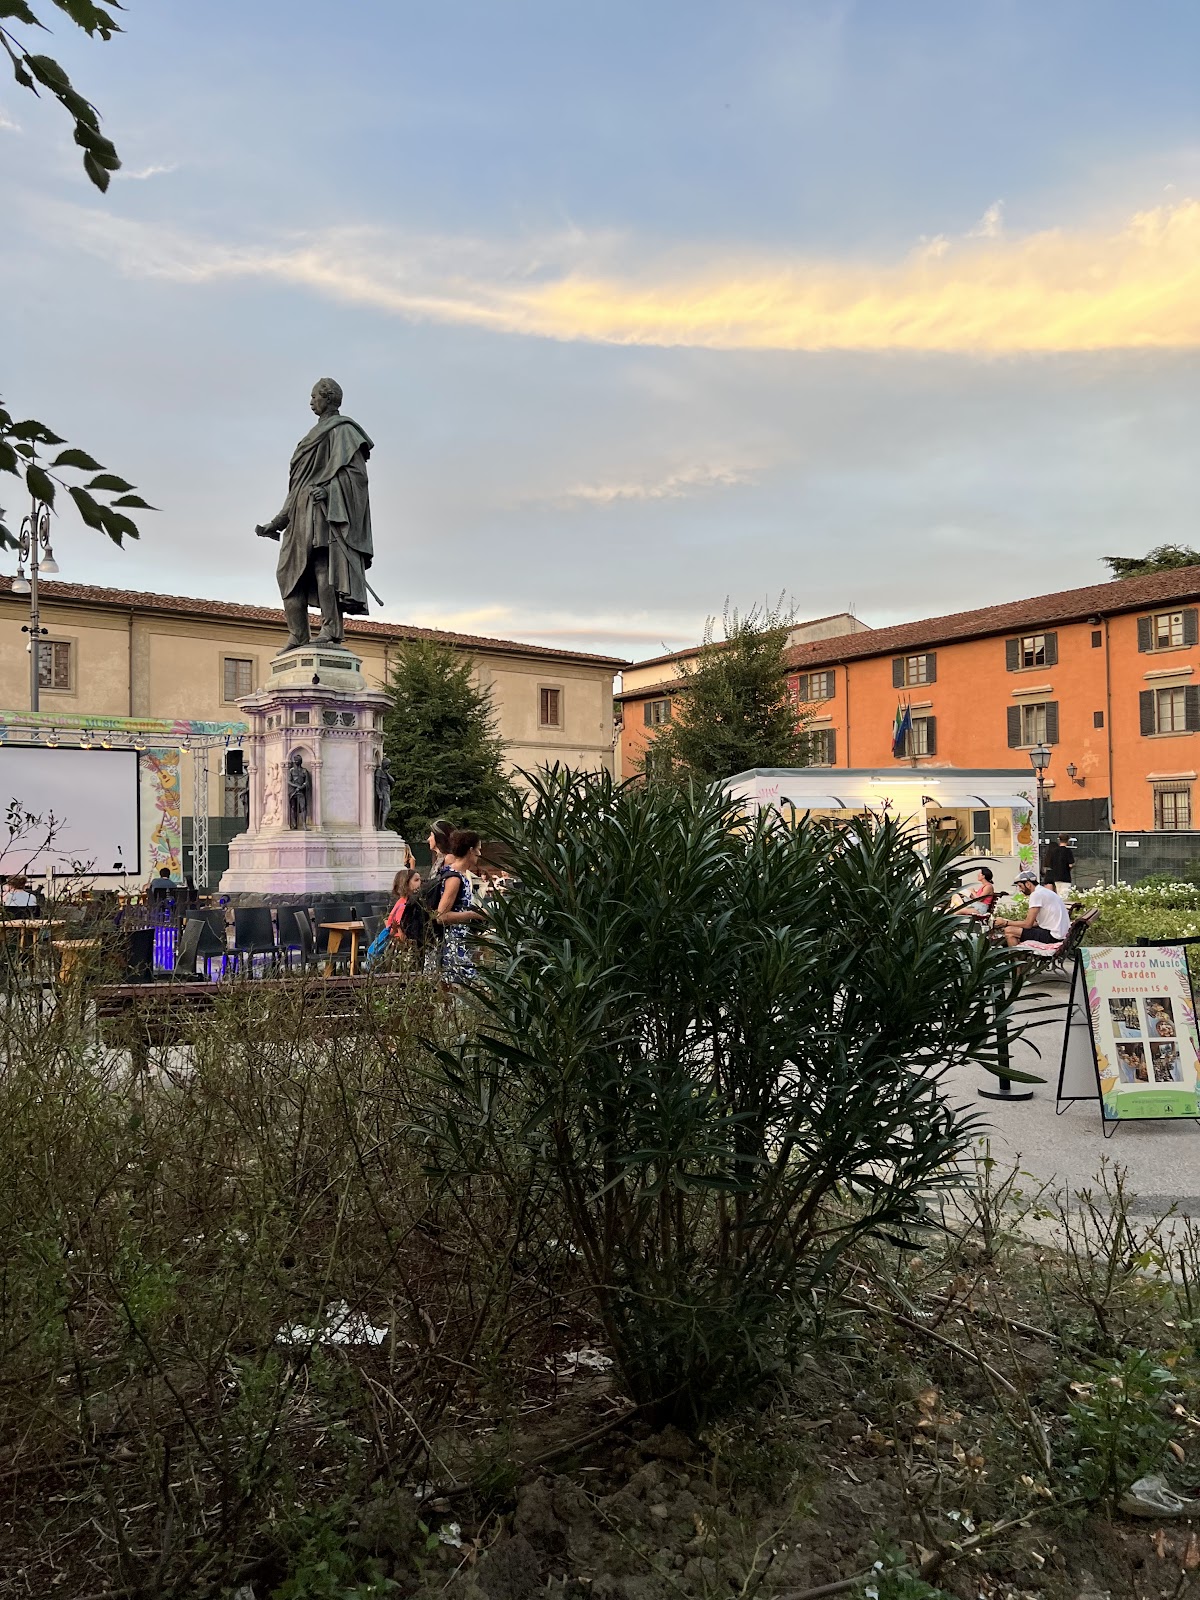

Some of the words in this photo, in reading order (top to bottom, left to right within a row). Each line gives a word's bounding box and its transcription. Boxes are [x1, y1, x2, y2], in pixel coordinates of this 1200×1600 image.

[40, 716, 80, 725] MARCO
[85, 718, 120, 728] MUSIC
[124, 720, 166, 730] GARDEN
[1124, 950, 1147, 958] 2022
[1091, 960, 1109, 969] San
[1112, 960, 1145, 968] Marco
[1149, 959, 1180, 968] Music
[1121, 970, 1156, 979] Garden
[1111, 986, 1148, 994] Apericena
